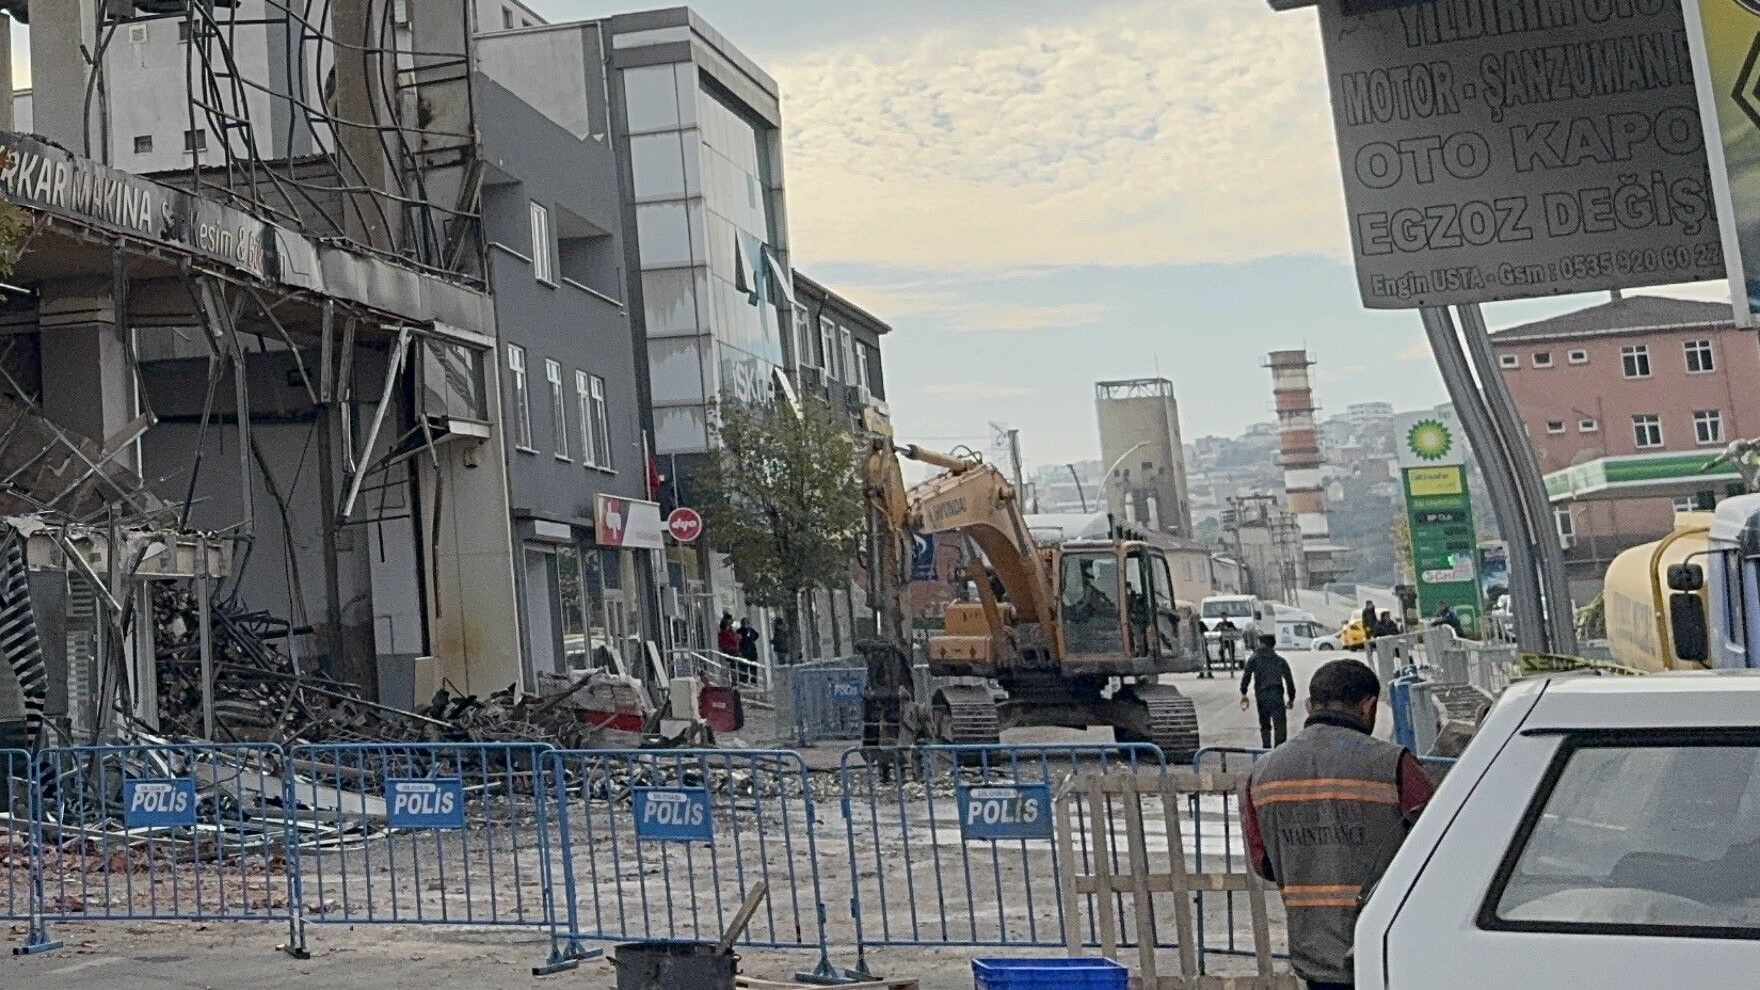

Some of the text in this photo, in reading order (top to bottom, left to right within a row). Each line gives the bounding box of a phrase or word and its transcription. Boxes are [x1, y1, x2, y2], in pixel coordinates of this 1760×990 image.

[1341, 61, 1460, 126] MOTOR
[1354, 131, 1490, 190] OTO
[1356, 195, 1533, 257] EGZOZ
[131, 785, 188, 813] POLİS
[394, 786, 454, 815] POLİS
[643, 797, 704, 826] POLİS
[967, 792, 1039, 825] POLİS
